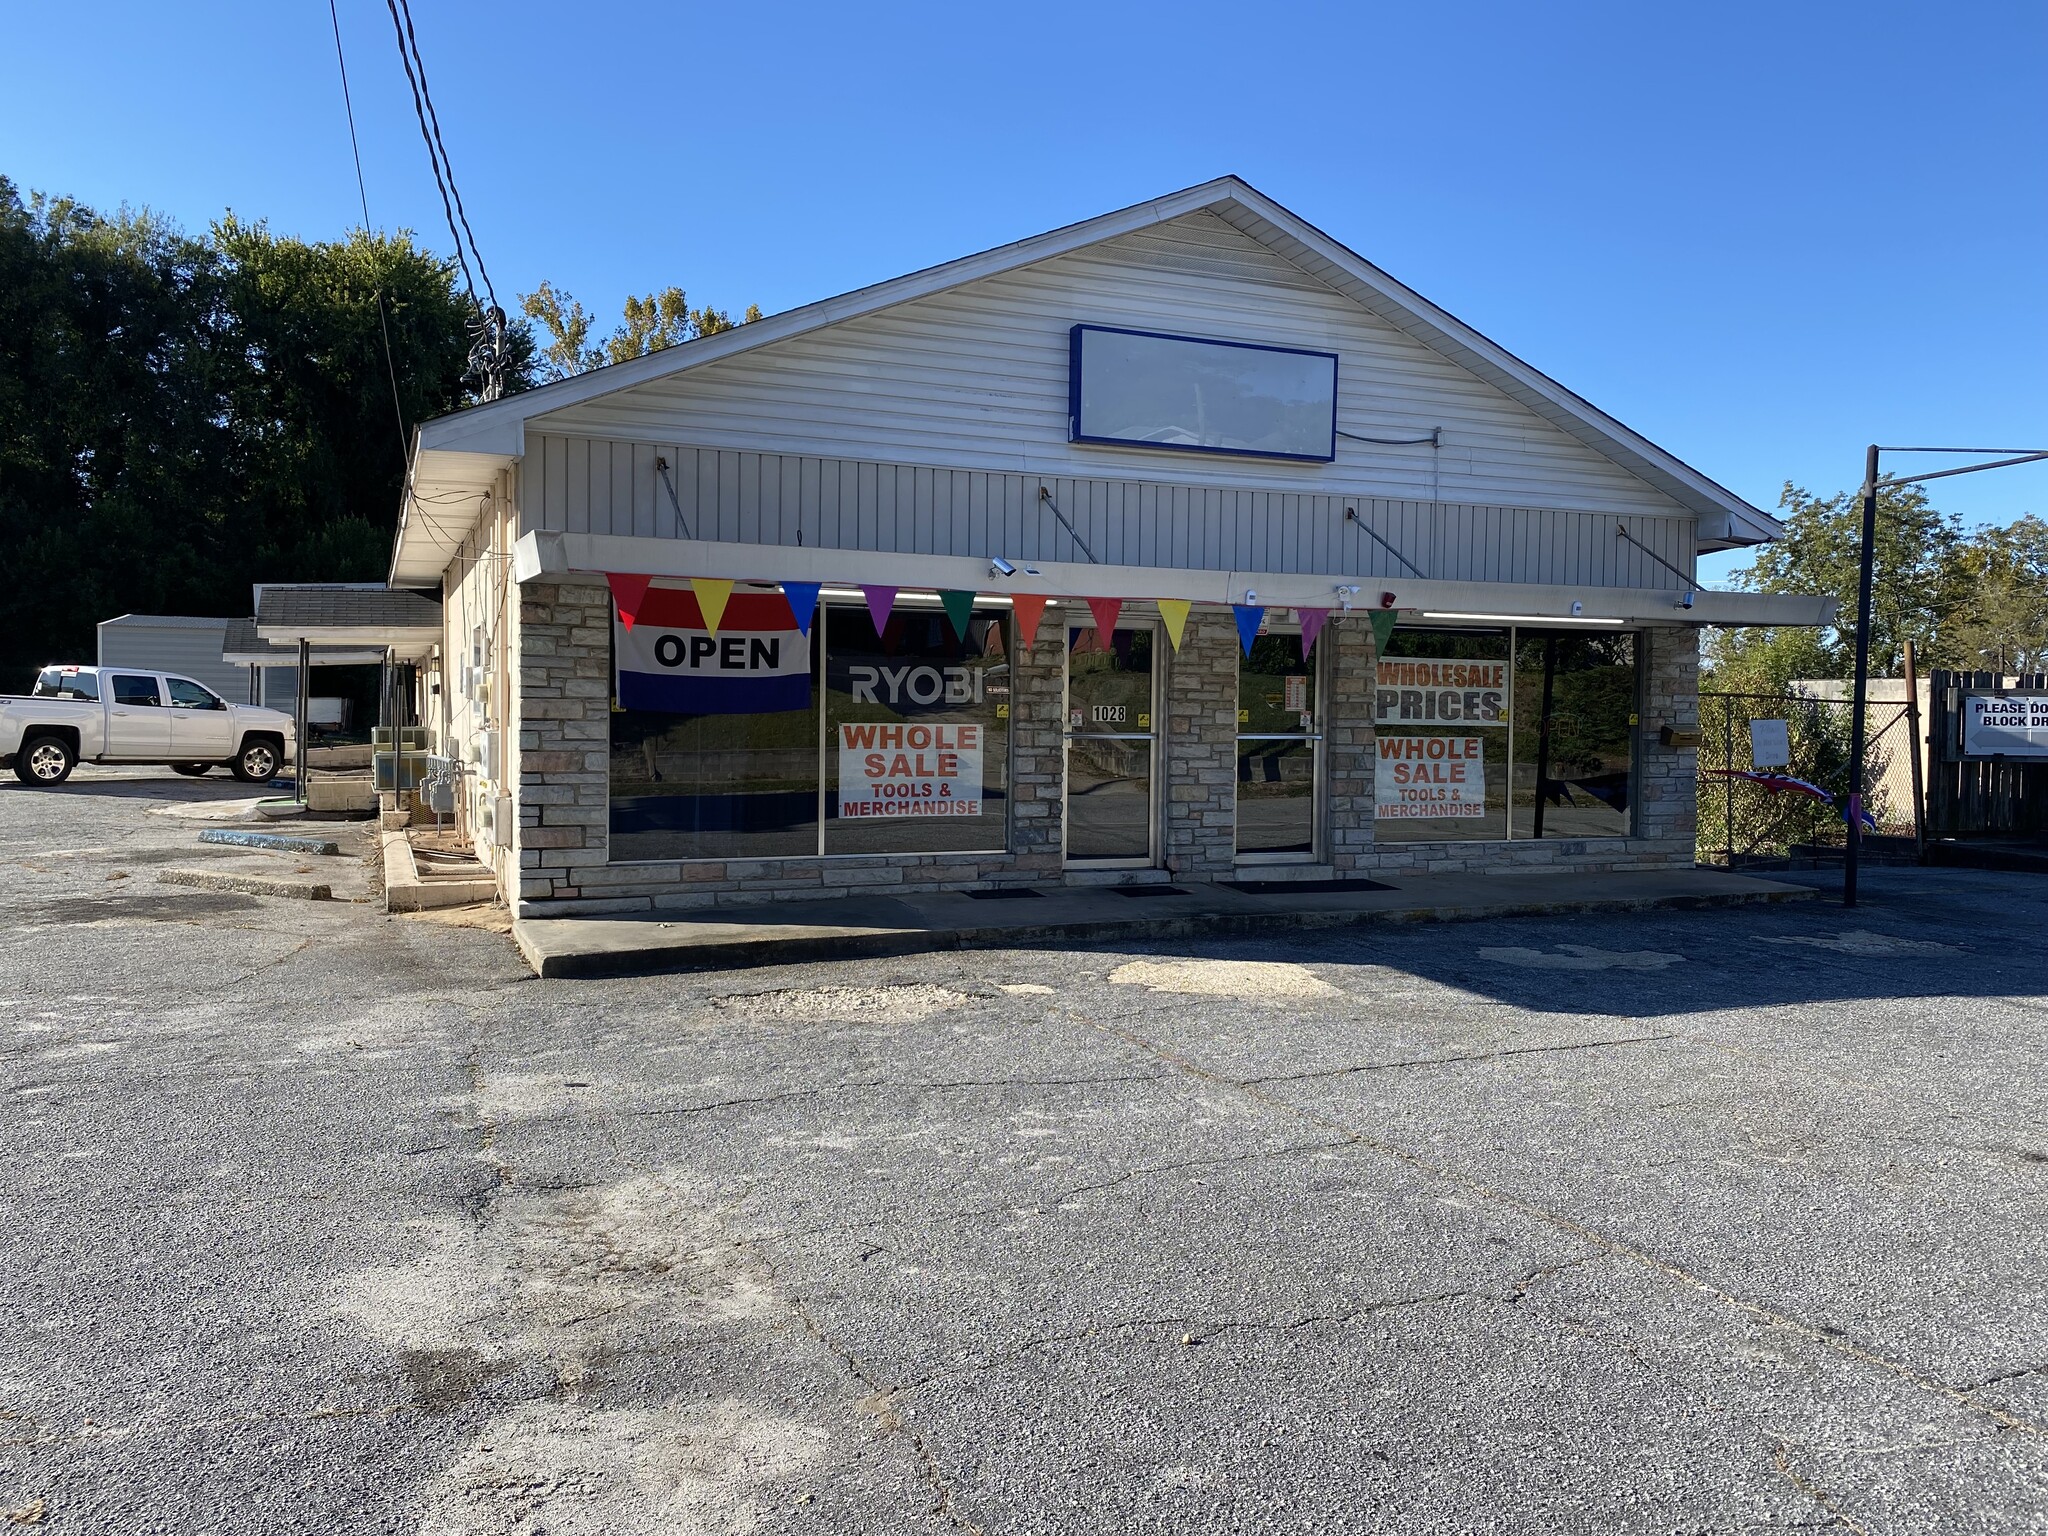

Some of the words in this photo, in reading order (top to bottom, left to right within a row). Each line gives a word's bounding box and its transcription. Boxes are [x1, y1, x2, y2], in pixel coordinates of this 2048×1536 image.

[654, 634, 780, 670] OPEN
[849, 665, 983, 705] RYOBI
[1376, 661, 1504, 689] WHOLESALE
[1094, 706, 1125, 721] 1028
[1376, 689, 1502, 721] PRICES
[1975, 703, 2026, 714] PLEASE
[1983, 716, 2027, 727] BLOCK
[843, 725, 977, 750] WHOLE
[1378, 738, 1479, 760] WHOLE
[864, 753, 958, 778] SALE
[1393, 762, 1466, 784] SALE
[871, 783, 932, 798] TOOLS
[939, 783, 951, 797] &
[1399, 788, 1446, 802] TOOLS
[1451, 788, 1461, 801] &
[844, 800, 978, 817] MERCHANDISE
[1378, 803, 1481, 818] MERCHANDISE
